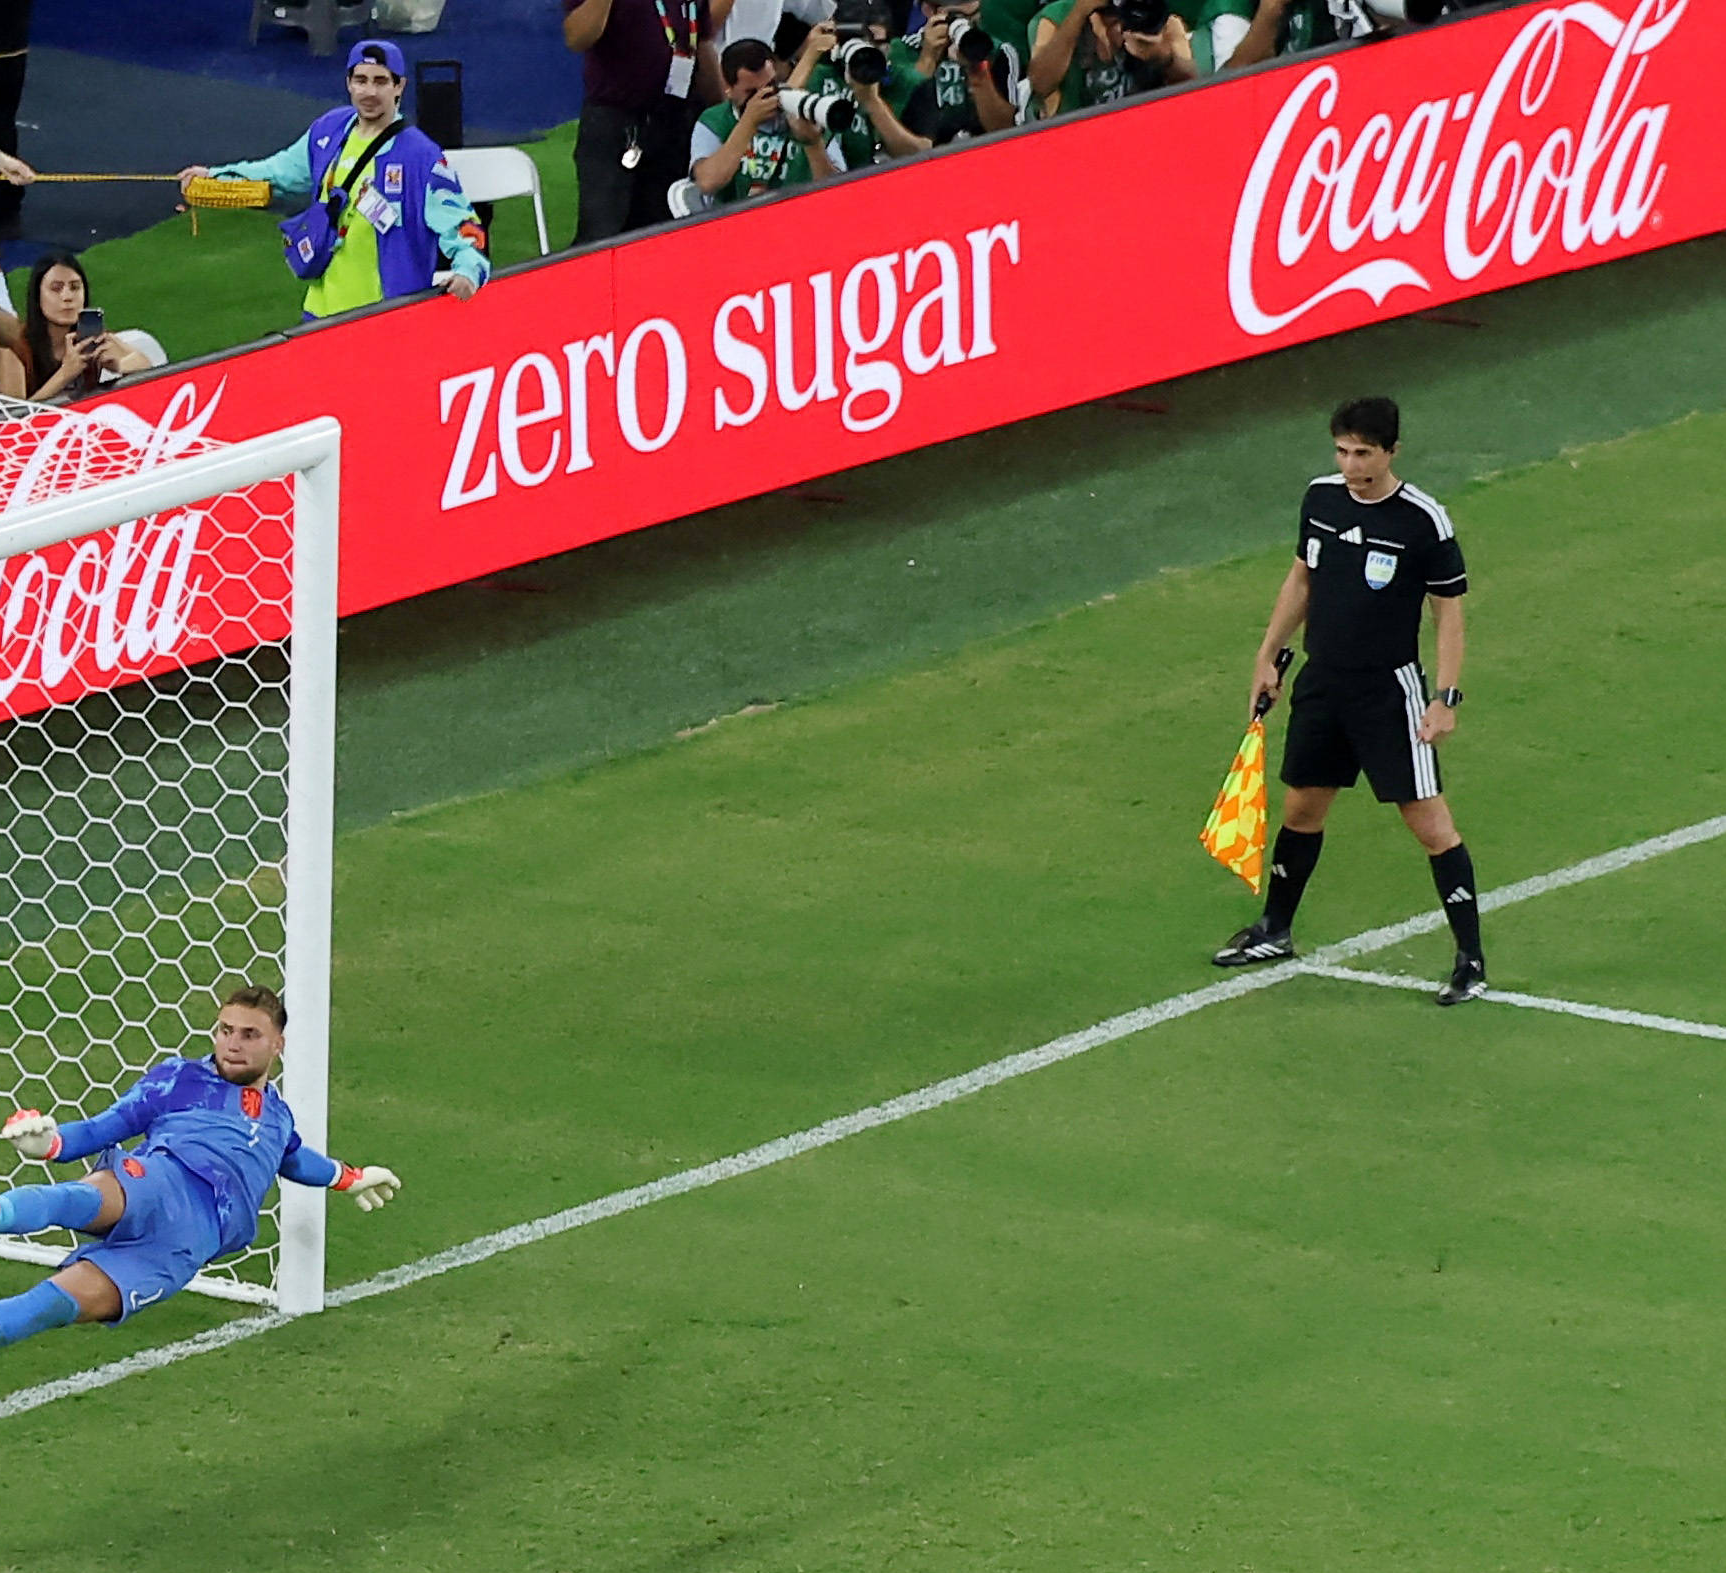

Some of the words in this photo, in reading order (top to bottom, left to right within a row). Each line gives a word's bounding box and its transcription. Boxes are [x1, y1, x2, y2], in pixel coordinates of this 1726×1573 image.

[1228, 0, 1688, 336] Coca-Cola
[440, 317, 687, 511] zero
[713, 220, 1019, 433] sugar
